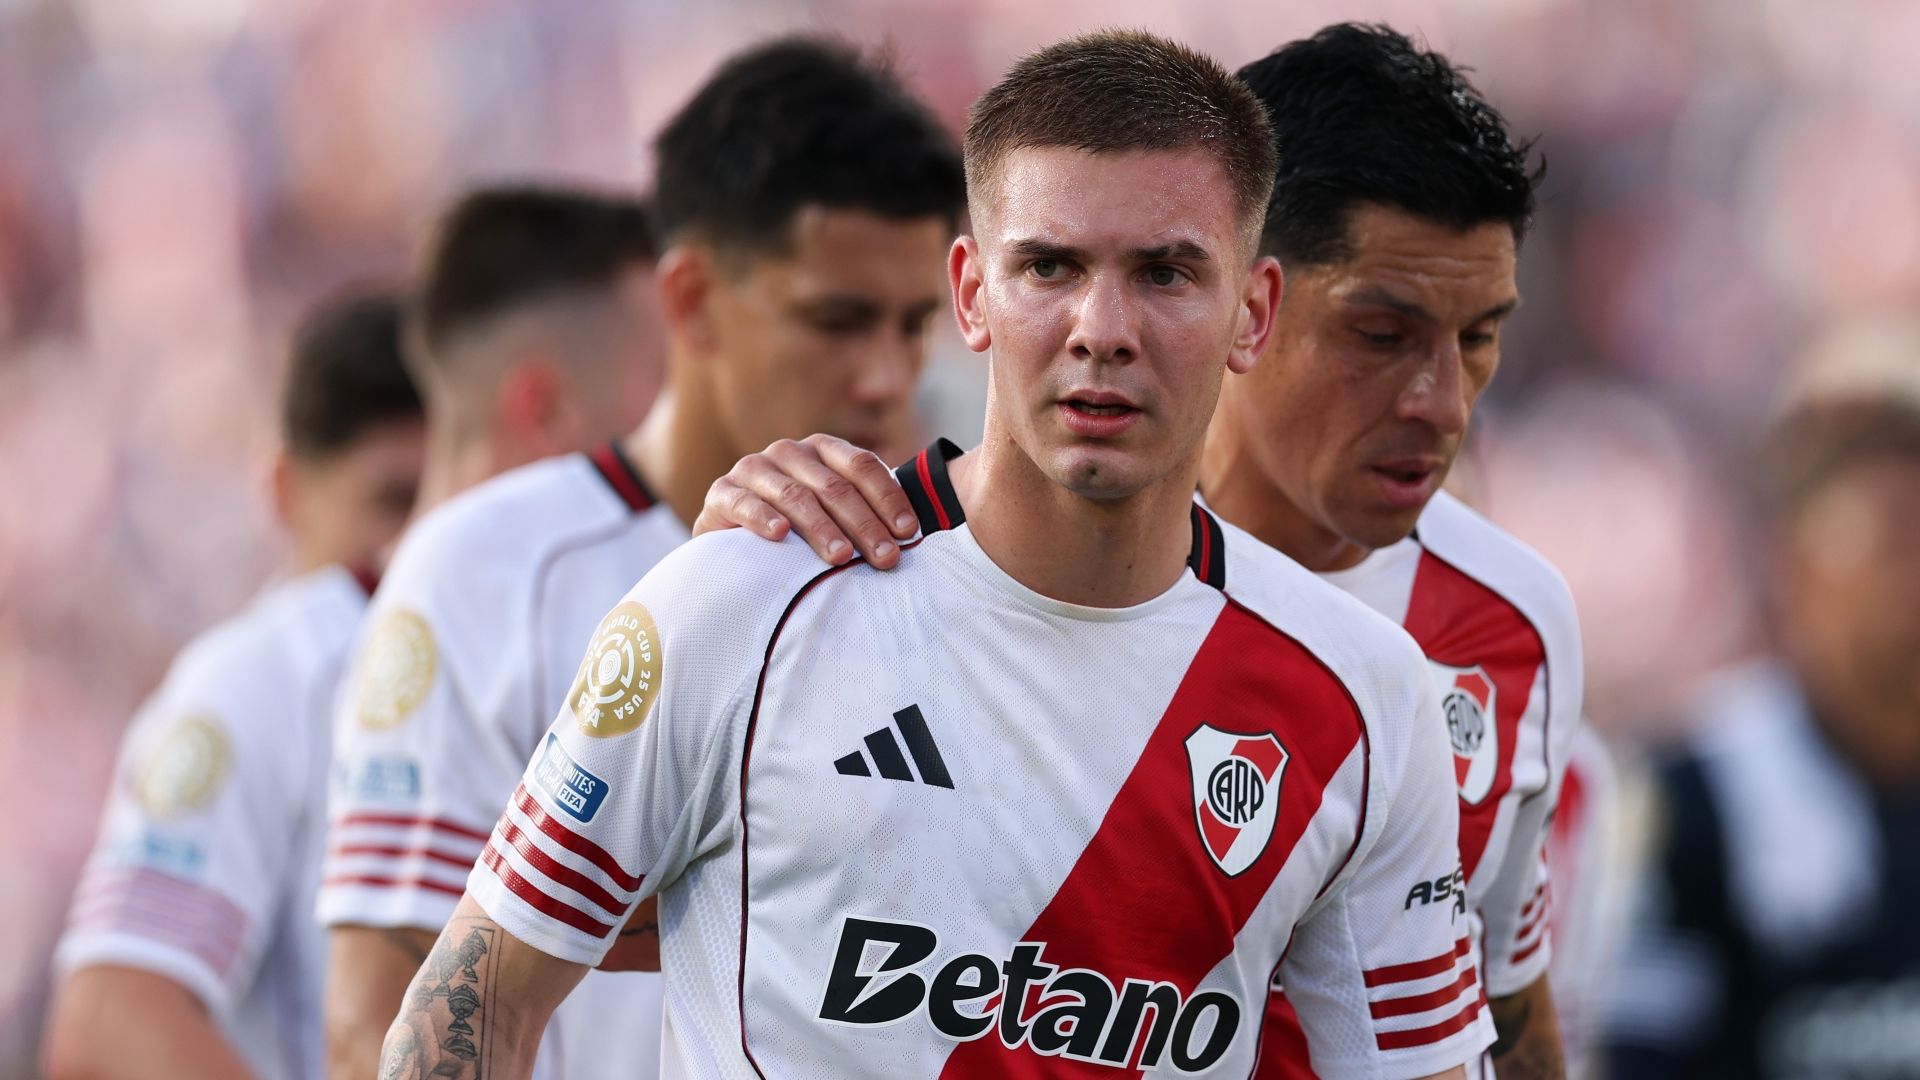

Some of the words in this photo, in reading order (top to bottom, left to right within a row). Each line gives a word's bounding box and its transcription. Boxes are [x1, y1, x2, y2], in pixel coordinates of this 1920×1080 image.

[636, 630, 651, 662] CUP
[638, 670, 651, 691] 25
[613, 694, 643, 720] USA
[563, 765, 596, 795] UNITES
[1207, 759, 1264, 824] CARP
[559, 787, 581, 810] FIFA
[817, 916, 1241, 1073] Betano
